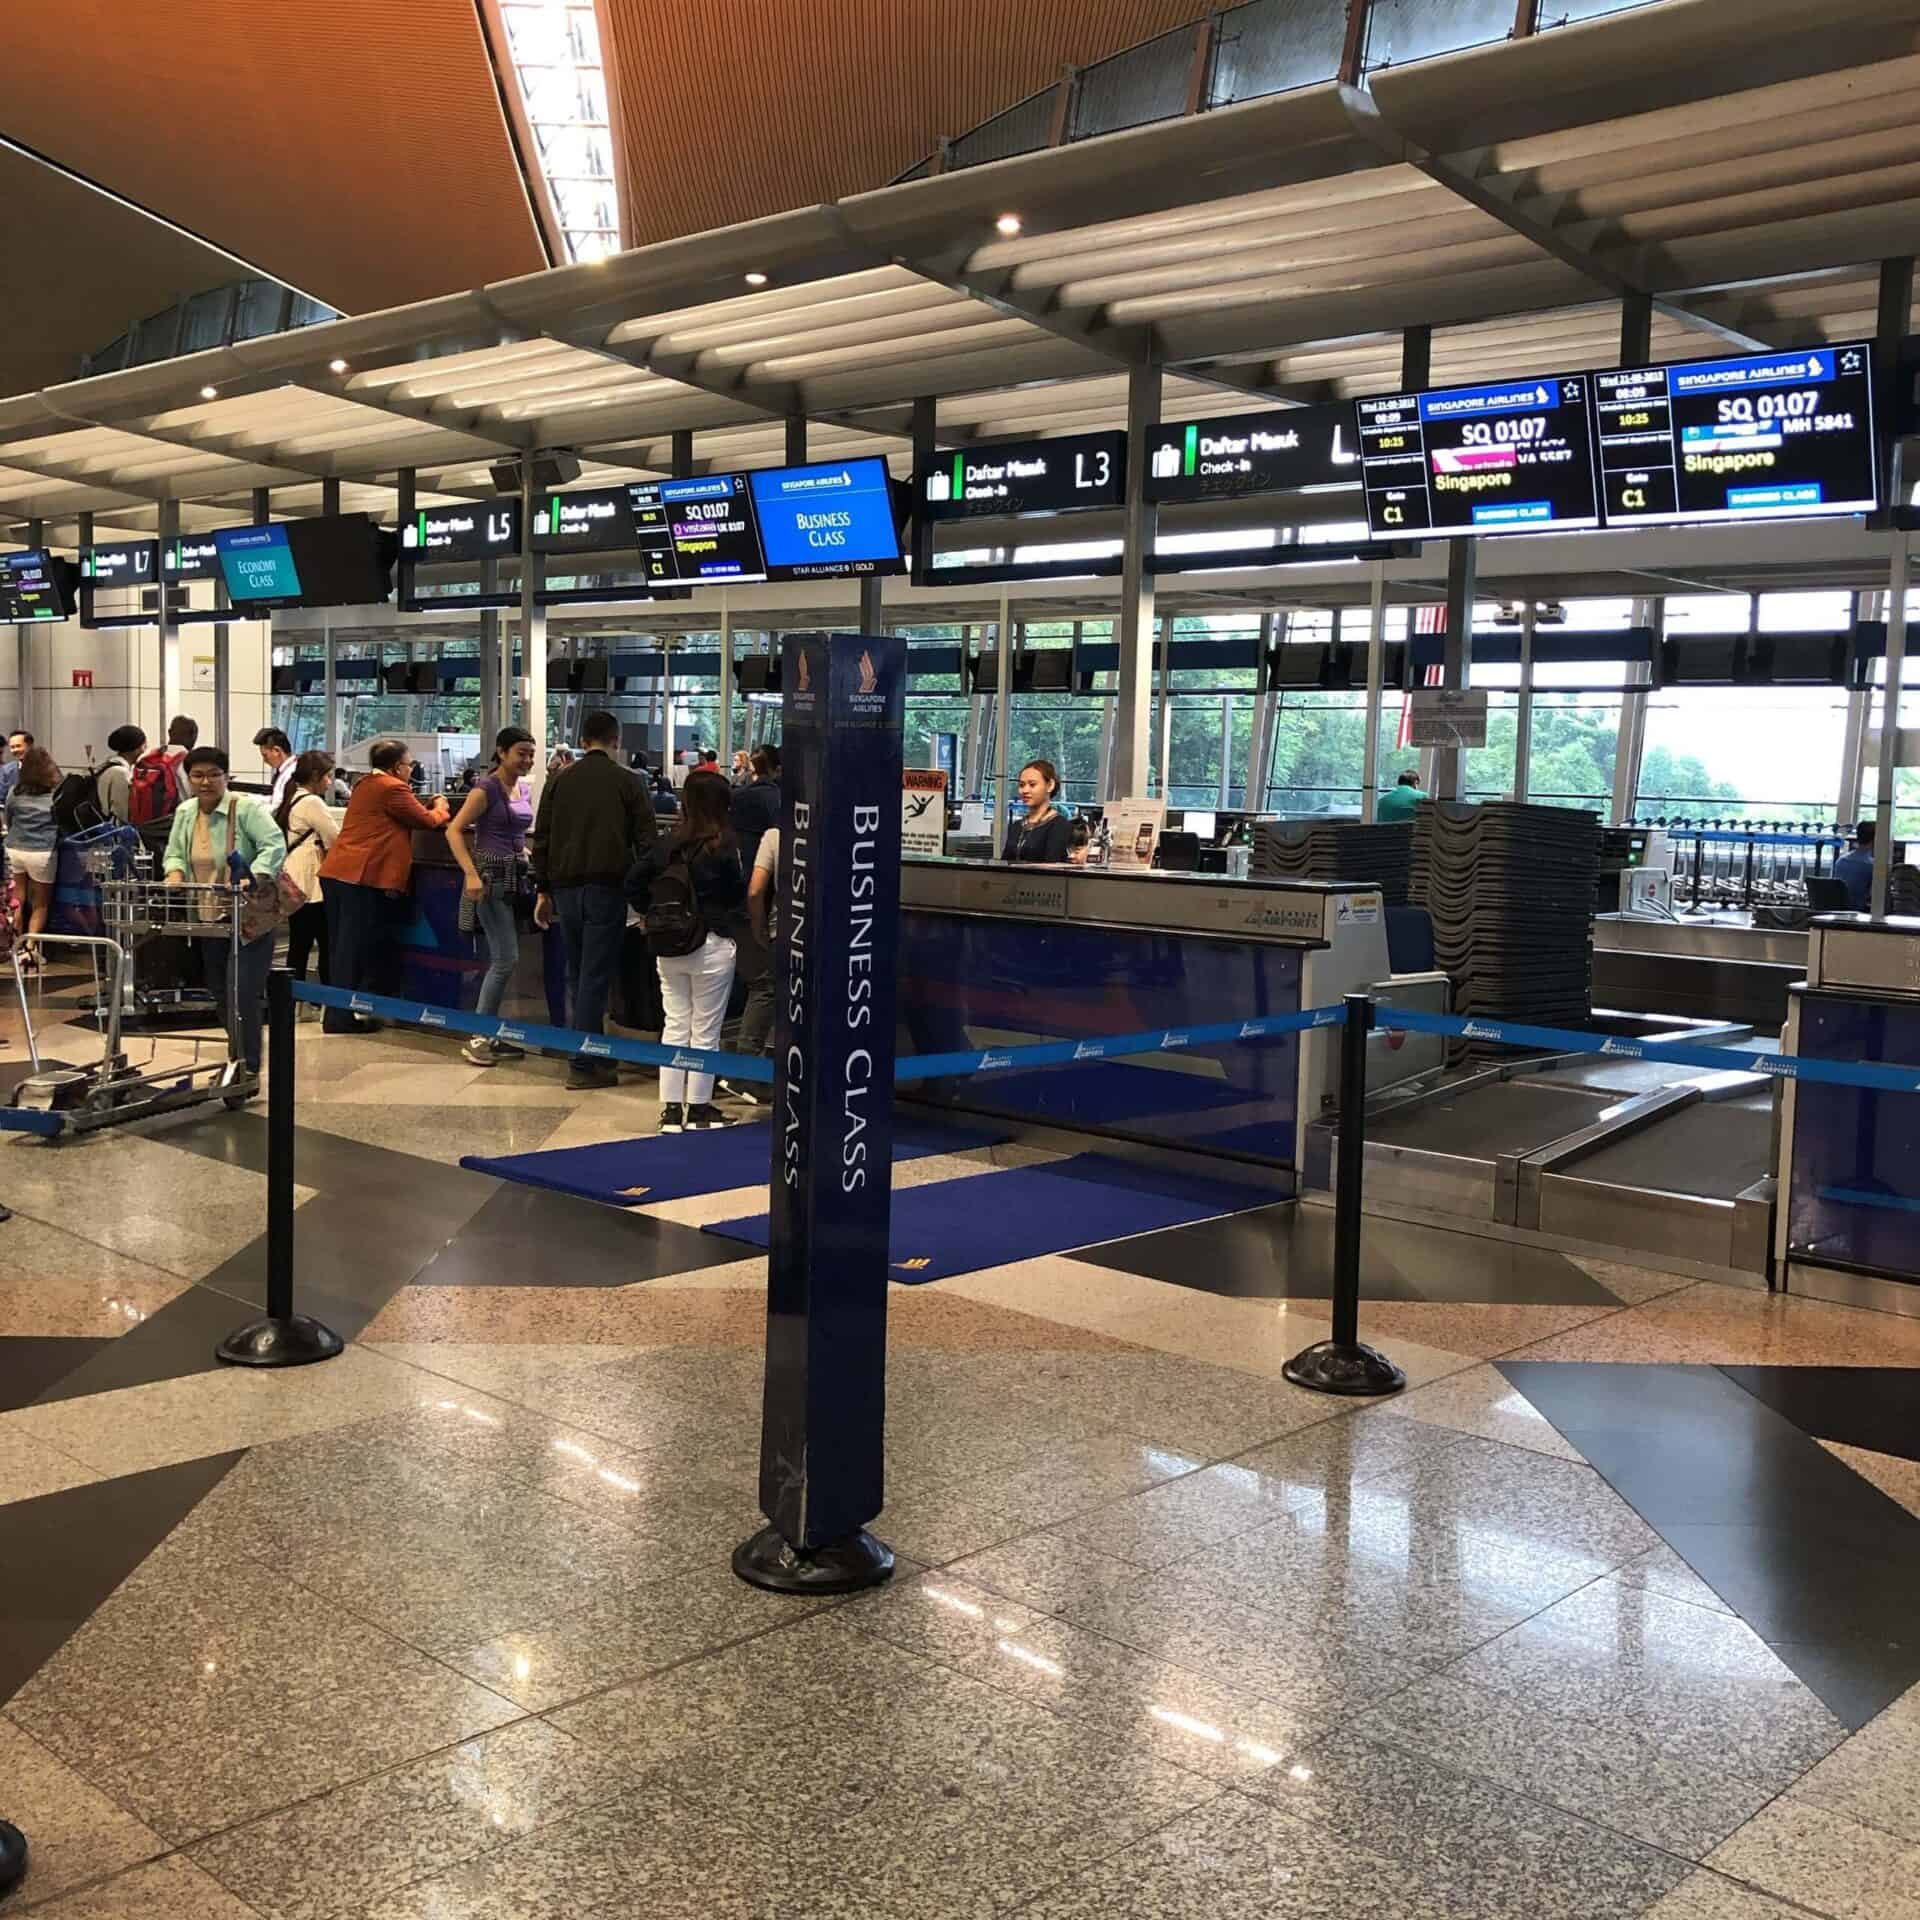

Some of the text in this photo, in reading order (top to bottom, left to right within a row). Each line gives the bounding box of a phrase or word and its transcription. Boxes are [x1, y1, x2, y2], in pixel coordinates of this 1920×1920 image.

[1678, 364, 1806, 386] SINGAPORE AIRLINES
[1427, 392, 1534, 412] SINGAPORE AIRLINES
[1718, 391, 1818, 422] SQ 0107
[1619, 412, 1649, 426] 10:25
[1783, 417, 1811, 434] MH
[1462, 424, 1493, 445] SQ
[1495, 418, 1546, 441] 0107
[1200, 429, 1299, 456] Daftar Masuk
[1331, 424, 1361, 464] L
[1075, 451, 1110, 488] L3
[1684, 451, 1775, 473] Singapore
[966, 464, 1005, 482] Daftar
[1435, 472, 1511, 492] Singapore
[1622, 489, 1646, 507] C1
[686, 502, 729, 520] SQ 0107
[1384, 507, 1404, 523] C1
[488, 512, 510, 542] L5
[796, 511, 852, 530] BUSINESS
[676, 541, 717, 554] Singapore
[809, 530, 846, 547] CLASS
[134, 551, 150, 574] L7
[238, 559, 276, 574] ECONOMY
[856, 562, 874, 571] GOLD
[249, 574, 274, 588] CLASS
[848, 695, 886, 704] SINGAPORE
[852, 704, 882, 713] AIRLINES
[905, 774, 943, 789] WARNING
[784, 802, 811, 1190] BUSINESS CLASS
[842, 804, 880, 1194] BUSINESS CLASS
